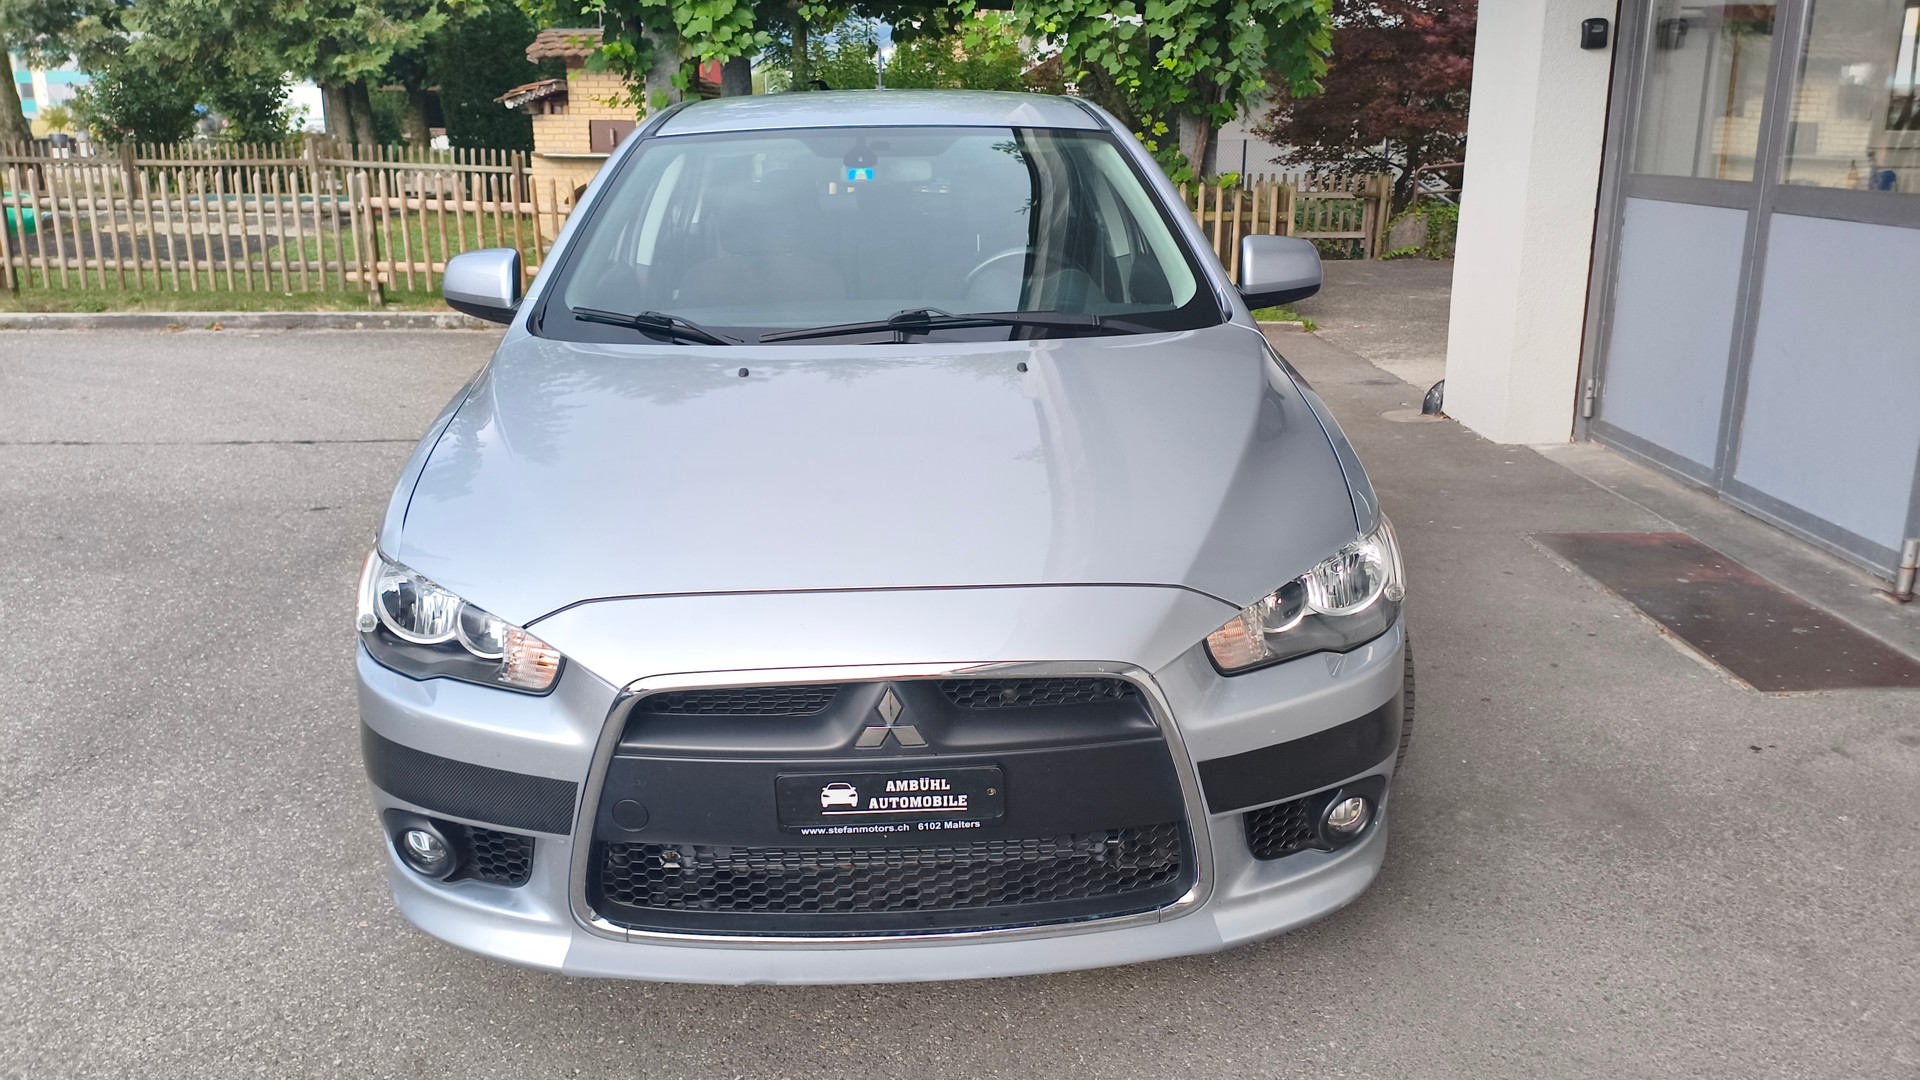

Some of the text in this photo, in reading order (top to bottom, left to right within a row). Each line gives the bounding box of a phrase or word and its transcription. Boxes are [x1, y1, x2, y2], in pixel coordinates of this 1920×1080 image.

[885, 777, 951, 792] AMBÜHL
[868, 794, 968, 809] AUTOMOBILE
[801, 820, 981, 835] www.stefanmotors.ch 6102 Malters
